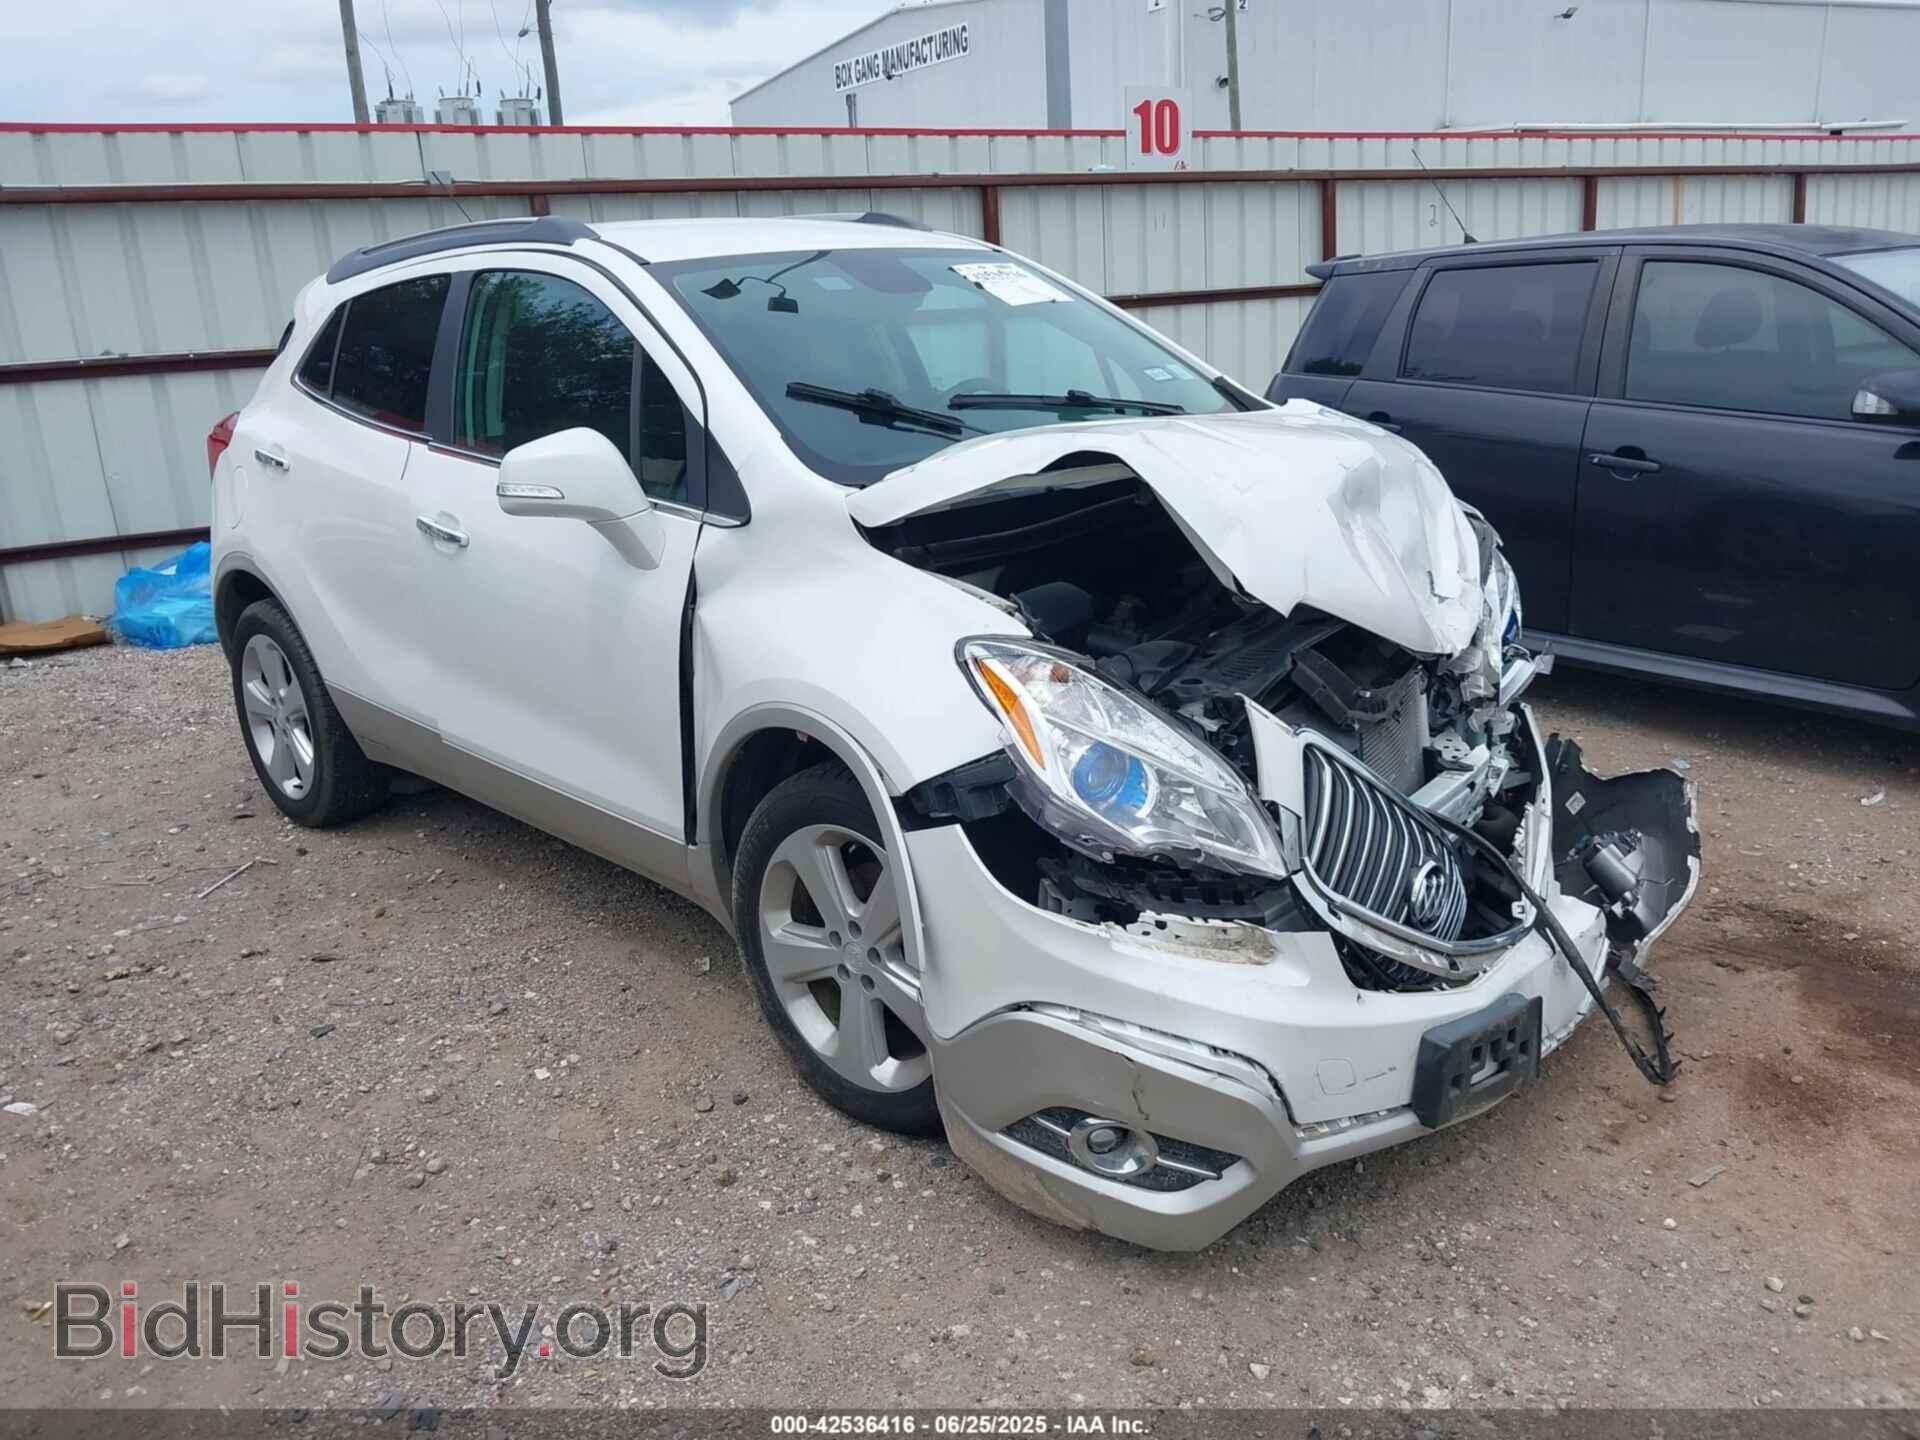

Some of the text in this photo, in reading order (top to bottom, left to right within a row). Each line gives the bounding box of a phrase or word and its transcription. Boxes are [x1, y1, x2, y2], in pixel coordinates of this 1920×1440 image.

[834, 24, 969, 89] BOX GANG MANUFACTURING
[1133, 98, 1180, 156] 10
